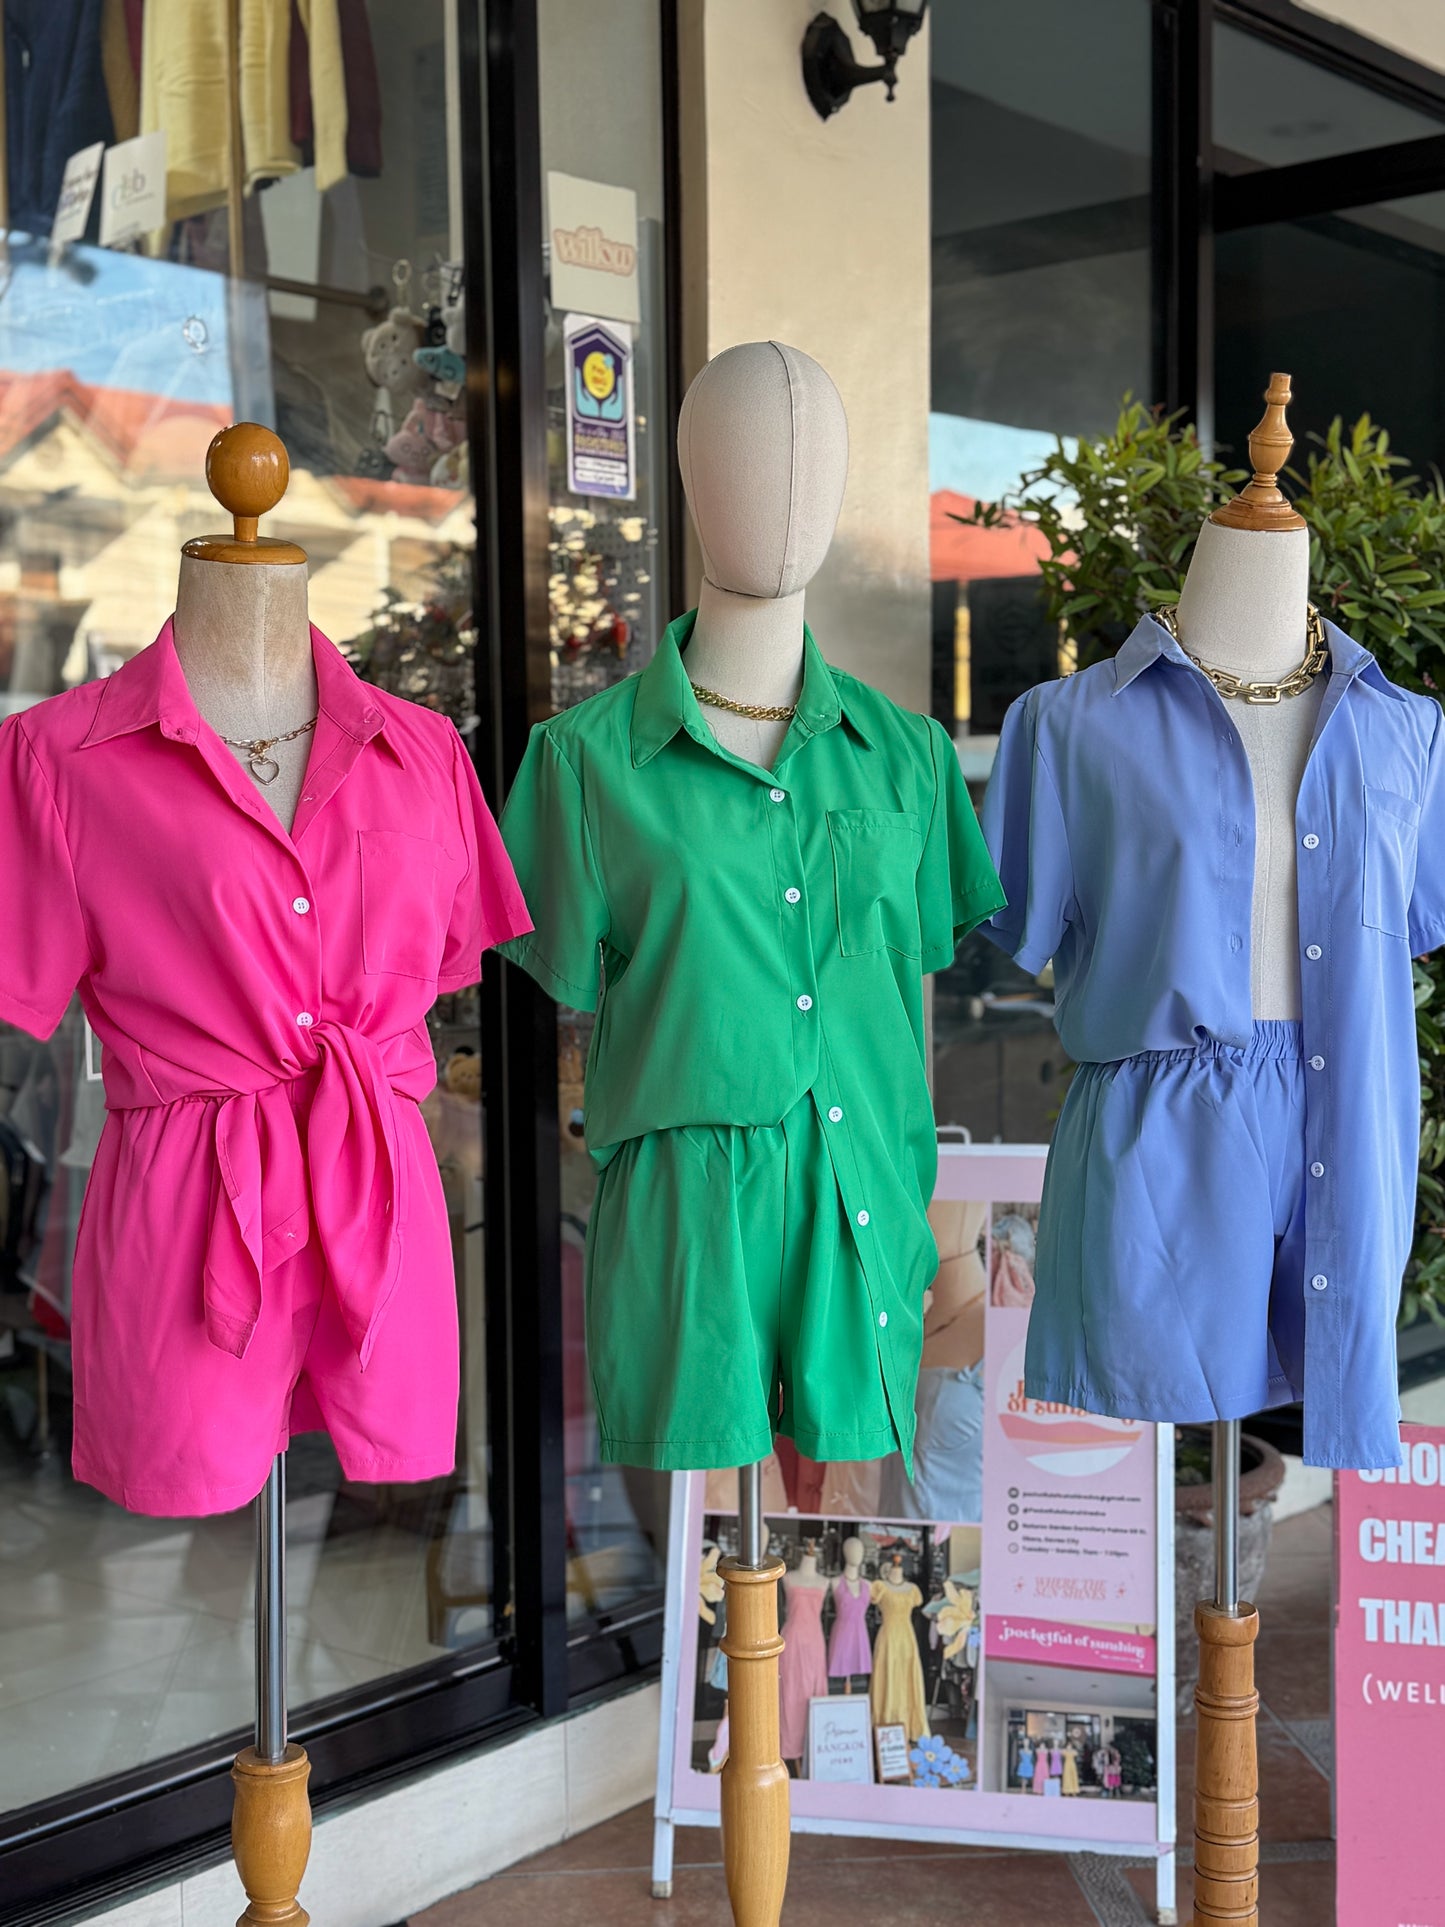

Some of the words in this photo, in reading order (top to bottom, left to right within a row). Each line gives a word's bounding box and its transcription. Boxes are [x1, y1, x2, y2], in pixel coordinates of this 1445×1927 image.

[1035, 1576, 1077, 1589] WHERE
[1082, 1579, 1108, 1591] THE
[1033, 1586, 1059, 1598] SUN
[1061, 1588, 1106, 1600] SHINES
[999, 1625, 1072, 1647] pocketful
[1074, 1636, 1090, 1648] of
